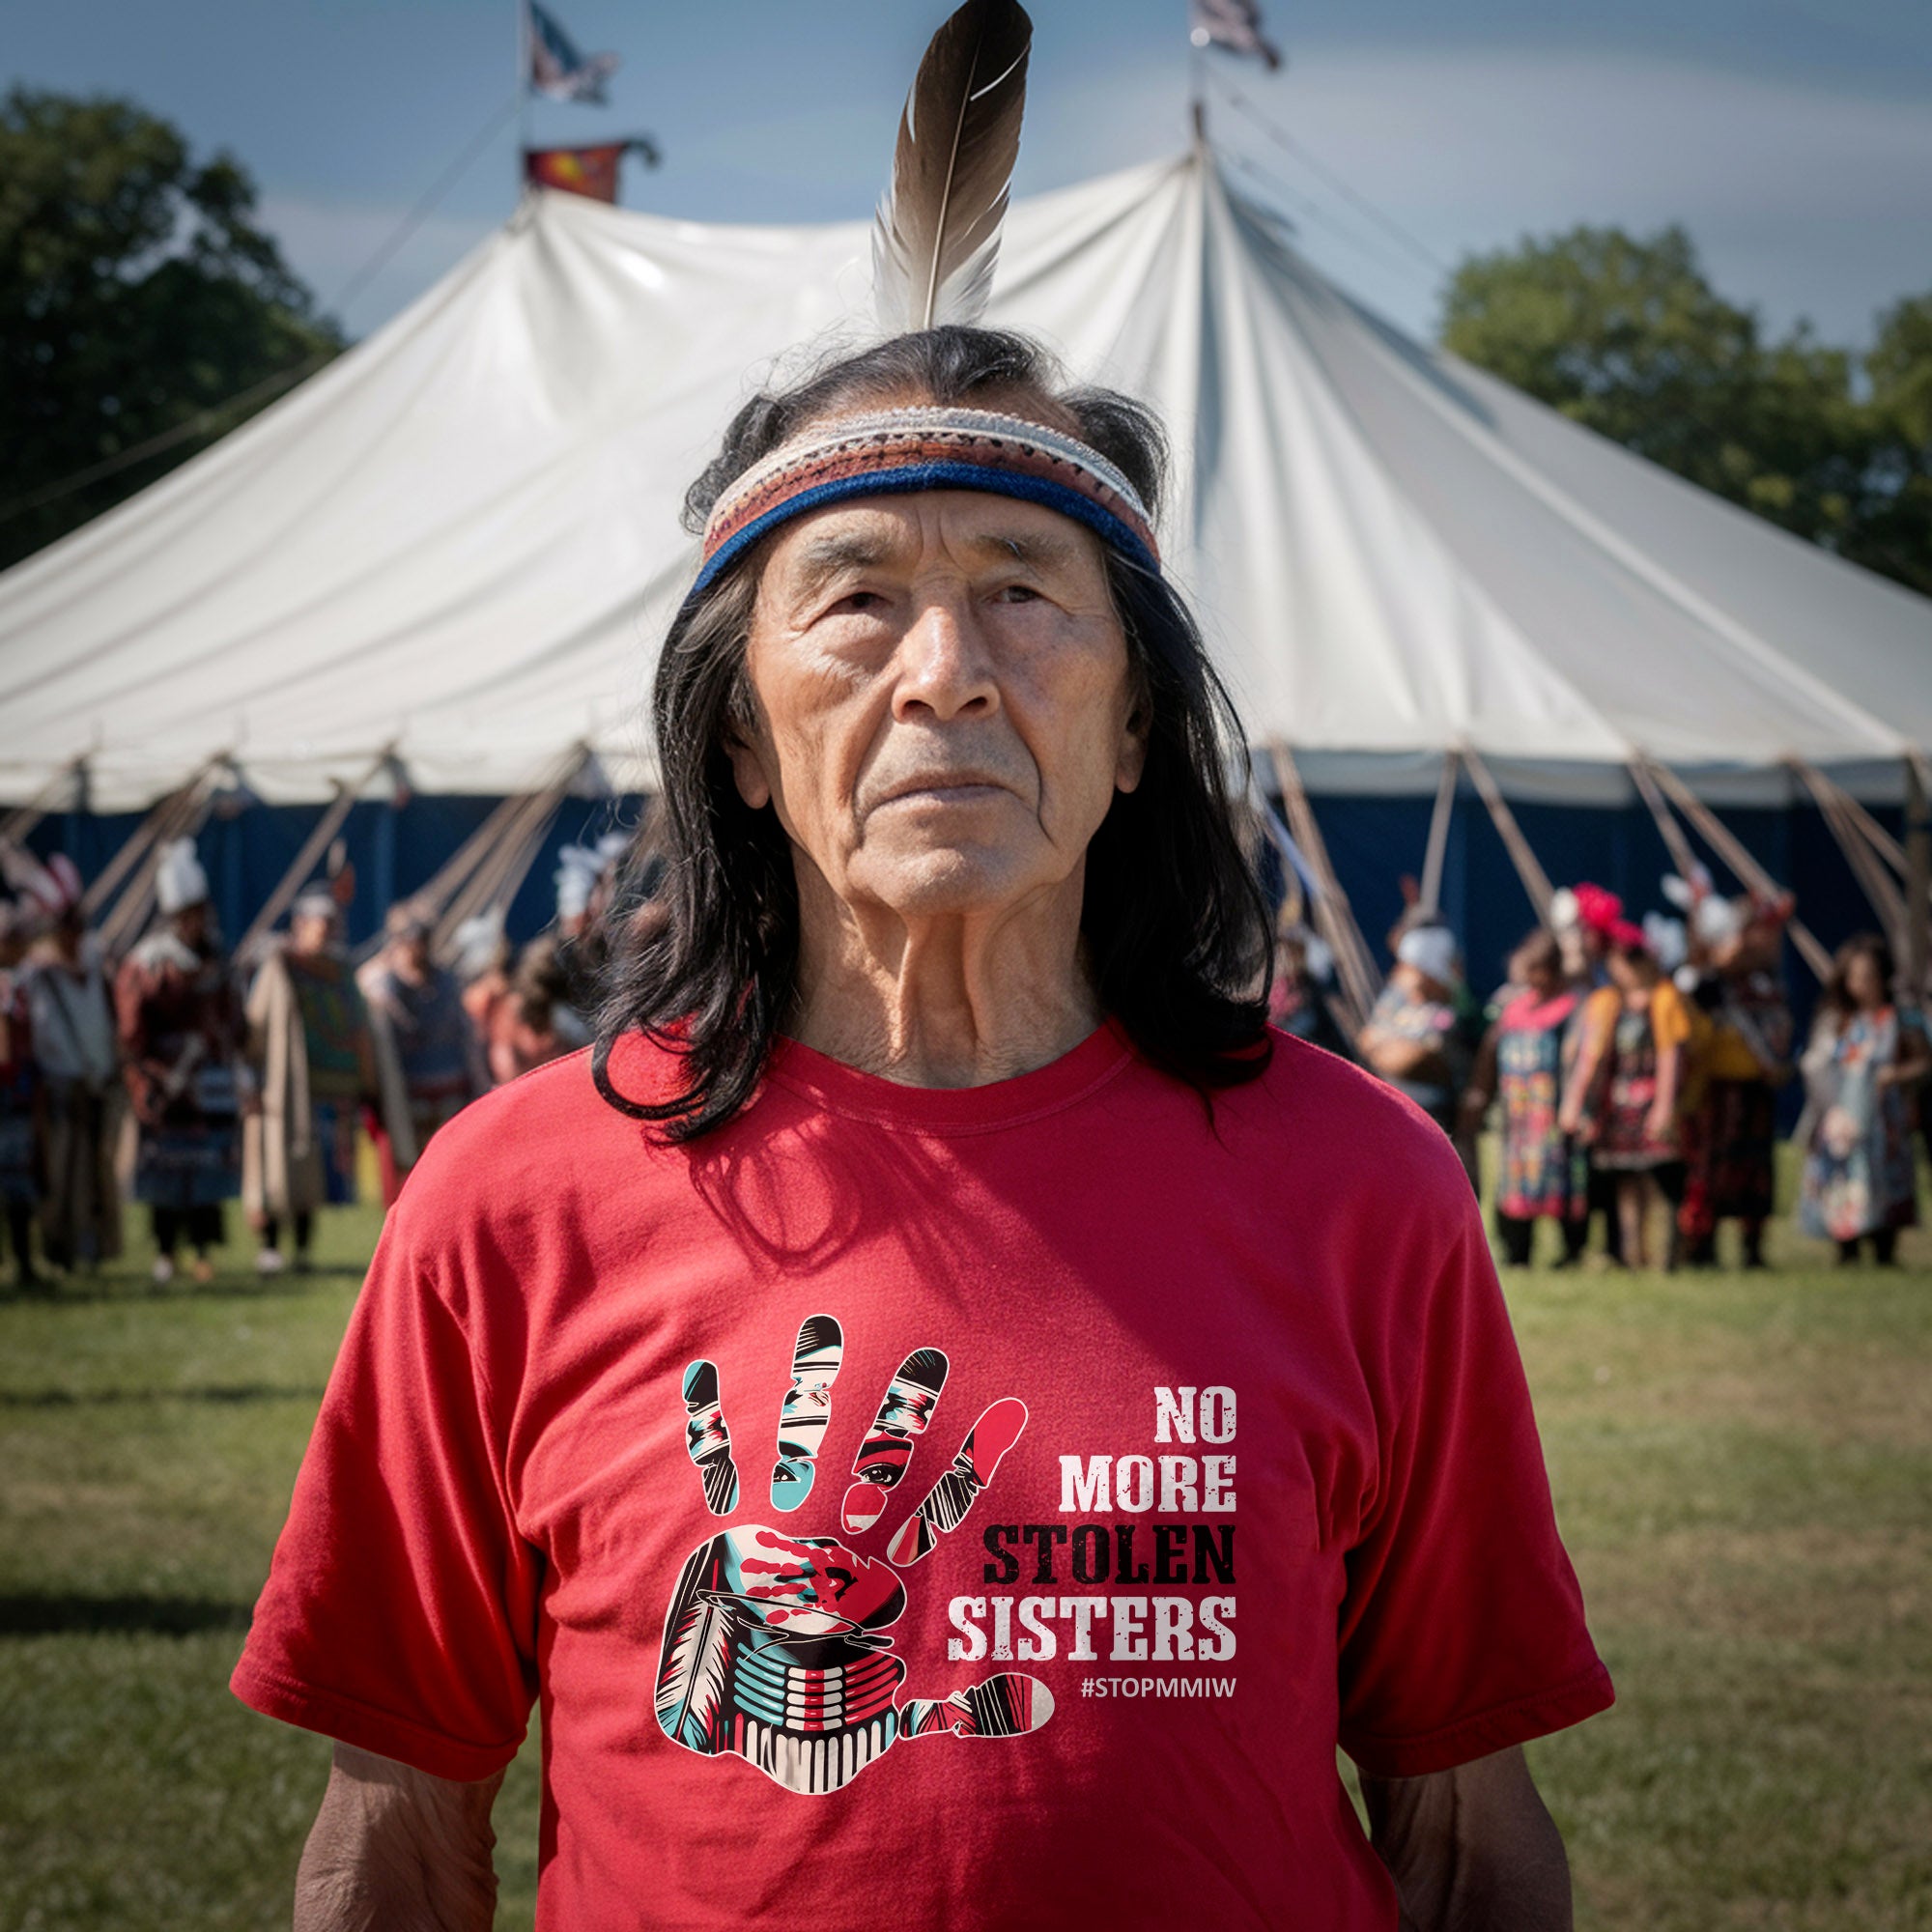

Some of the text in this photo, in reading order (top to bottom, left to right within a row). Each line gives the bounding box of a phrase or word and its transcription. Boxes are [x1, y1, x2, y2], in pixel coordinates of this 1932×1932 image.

[1153, 1385, 1237, 1444] NO
[1059, 1454, 1237, 1513] MORE
[983, 1523, 1237, 1585] STOLEN
[948, 1596, 1237, 1662] SISTERS
[1081, 1677, 1237, 1698] #STOPMMIW
